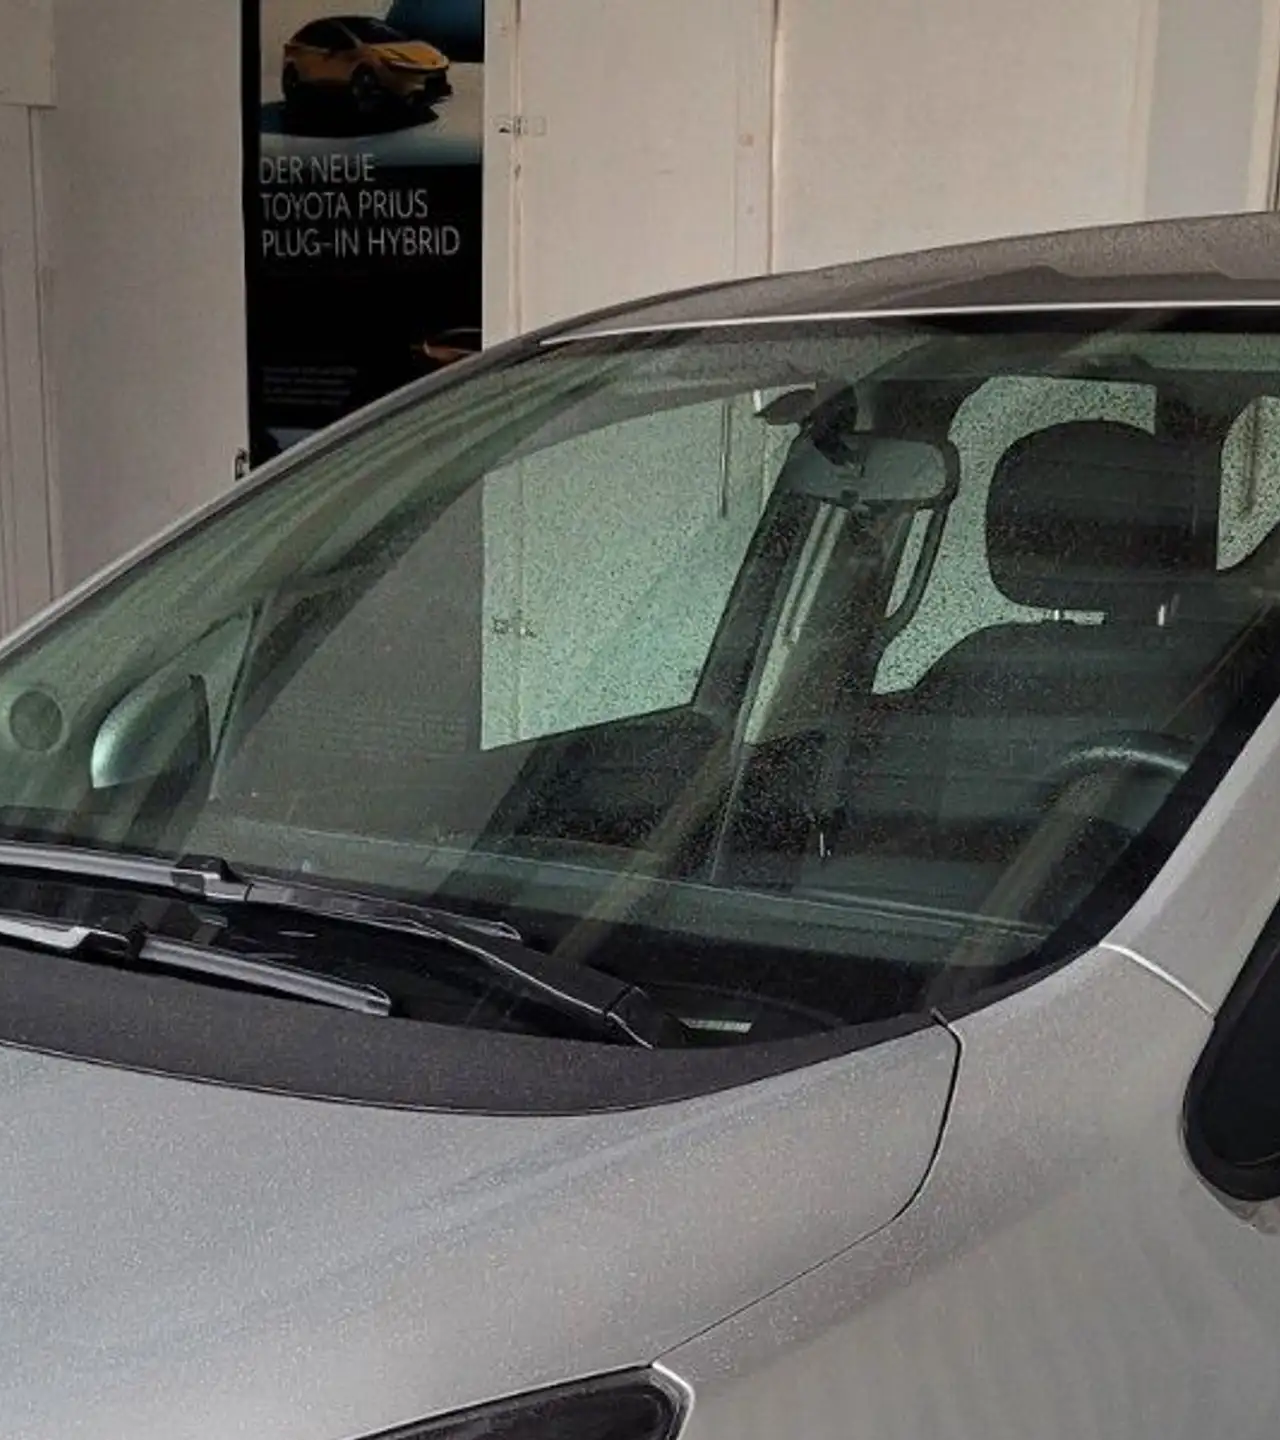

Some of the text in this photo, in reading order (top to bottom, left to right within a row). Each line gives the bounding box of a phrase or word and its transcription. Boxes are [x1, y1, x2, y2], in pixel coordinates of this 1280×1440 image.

[258, 153, 376, 185] DER NEUE
[260, 188, 429, 221] TOYOTA PRIUS
[262, 225, 461, 258] PLUG-IN HYBRID
